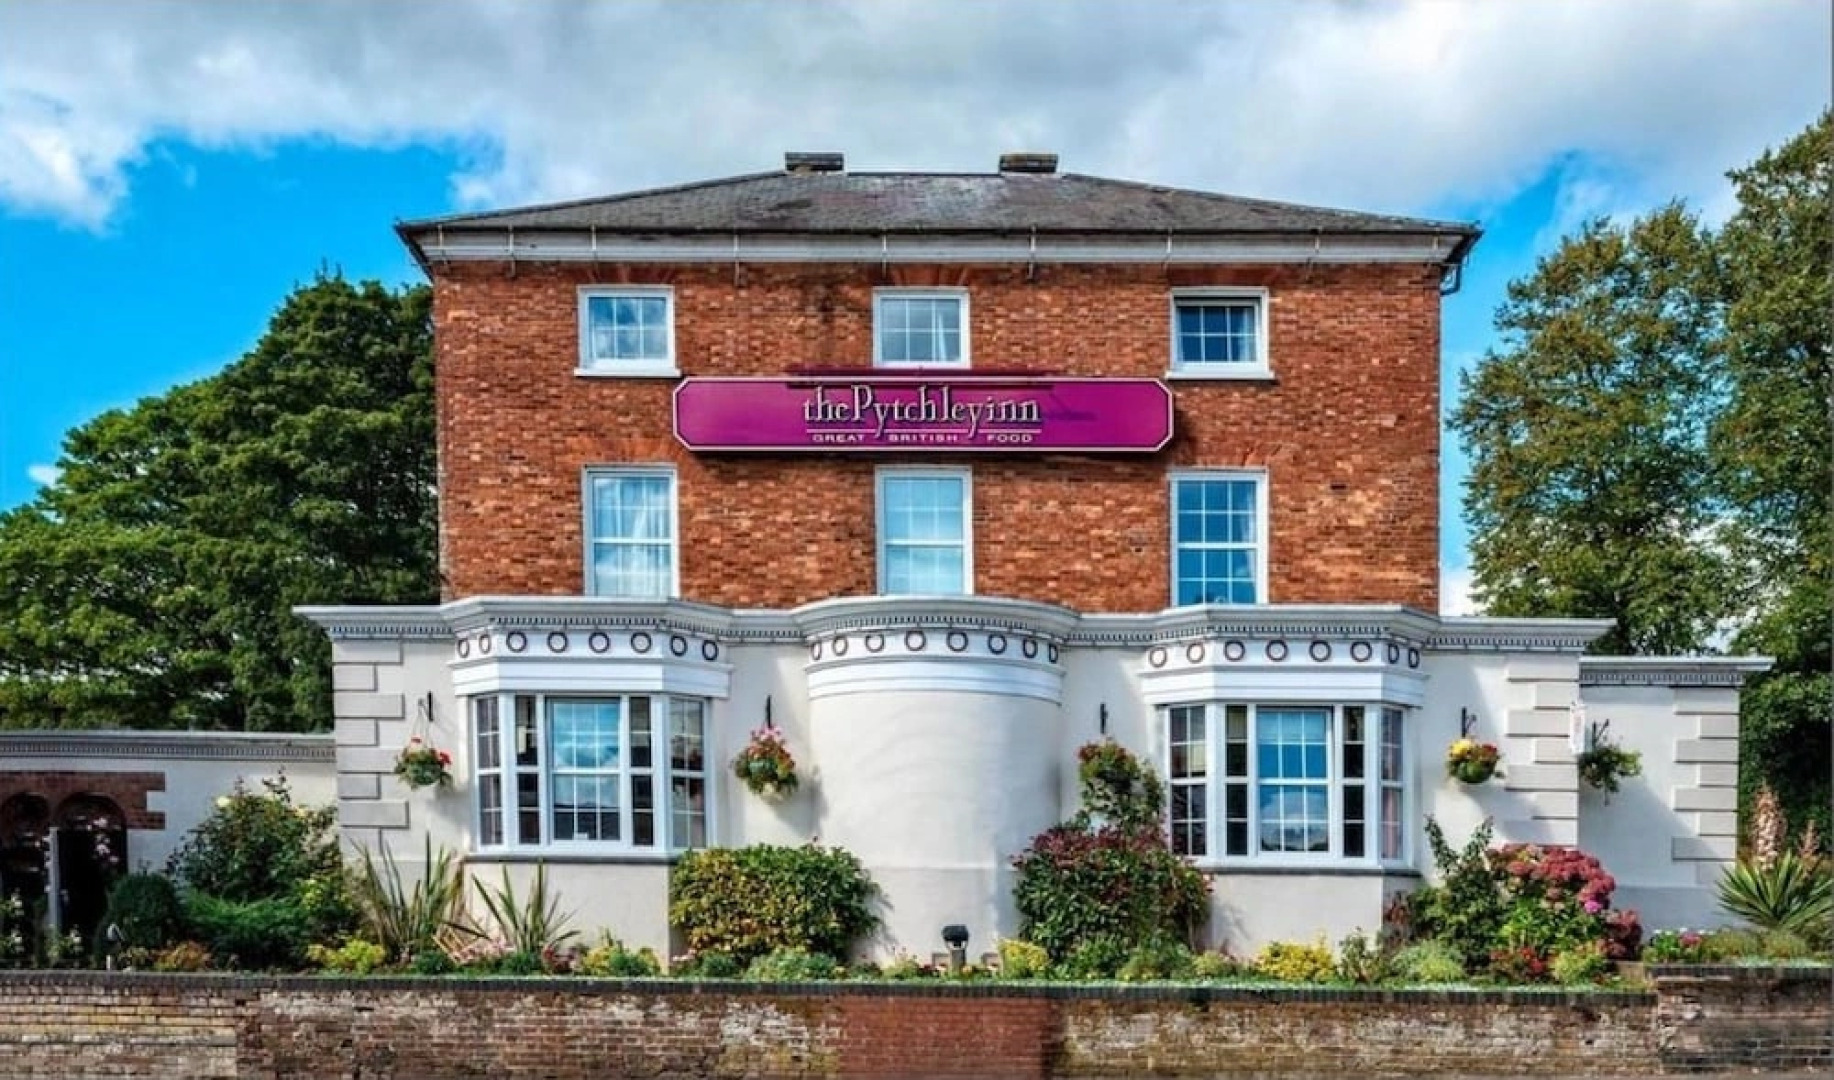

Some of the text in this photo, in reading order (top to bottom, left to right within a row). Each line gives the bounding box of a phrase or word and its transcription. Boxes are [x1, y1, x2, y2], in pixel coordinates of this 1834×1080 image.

[812, 433, 1033, 443] GREAT BRITISH FOOD
